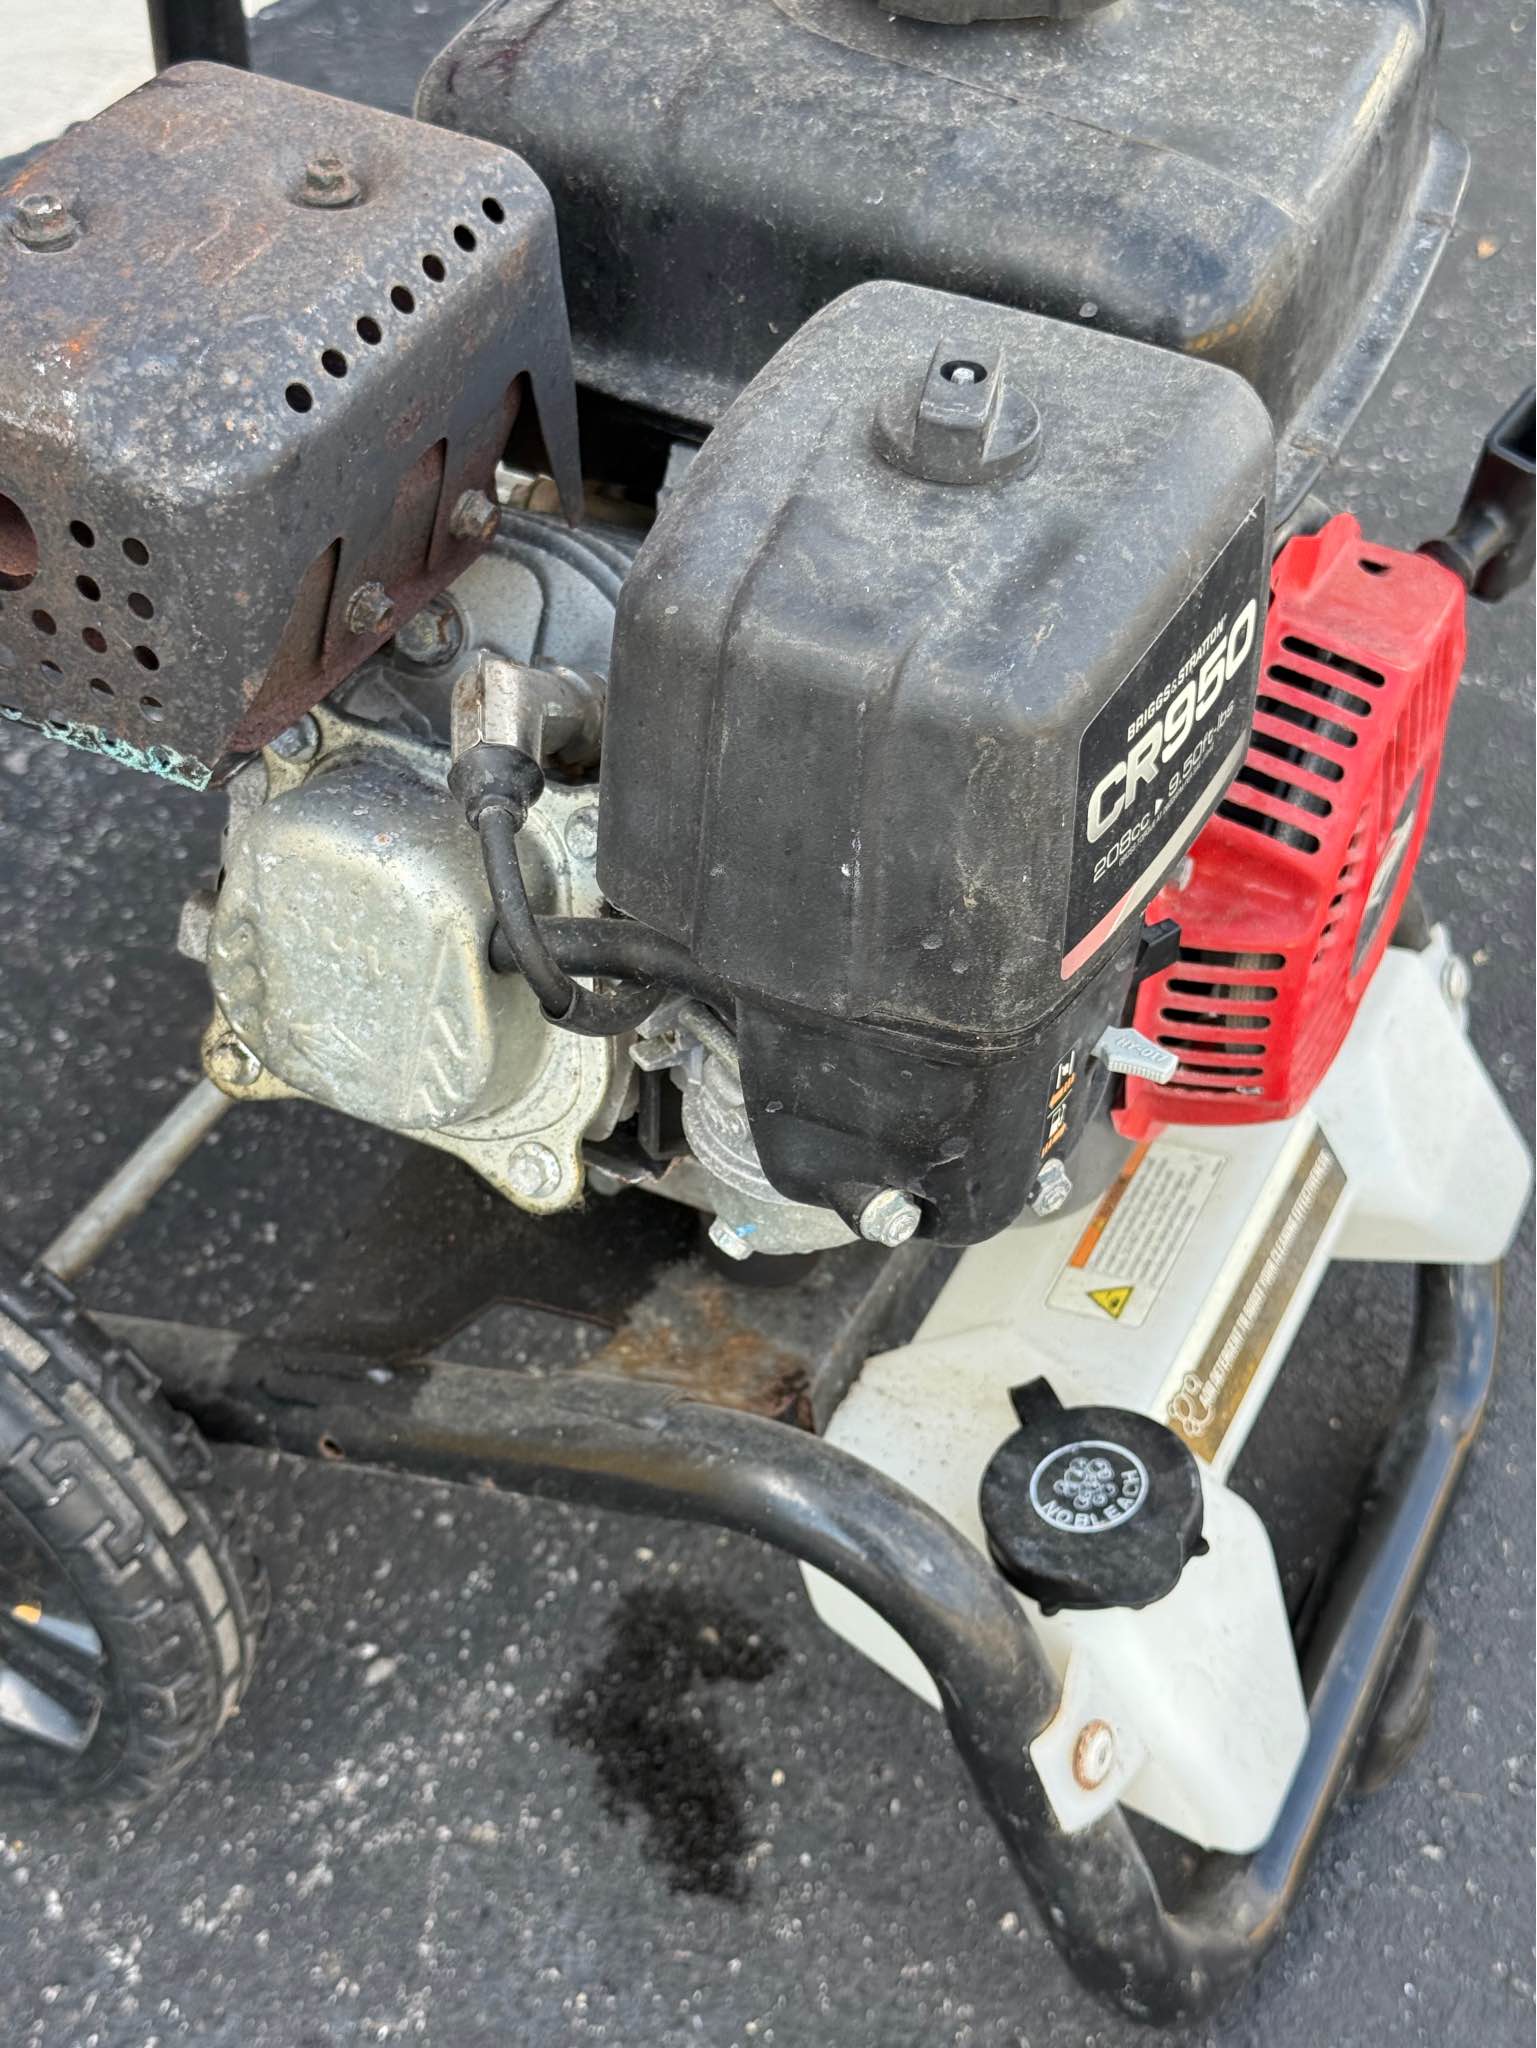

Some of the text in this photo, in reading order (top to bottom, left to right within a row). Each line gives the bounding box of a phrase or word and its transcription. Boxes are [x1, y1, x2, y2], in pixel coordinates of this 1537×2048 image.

[1087, 598, 1257, 843] CR950
[1093, 812, 1150, 883] 208cc
[1168, 699, 1235, 797] 9.50ft-lbs
